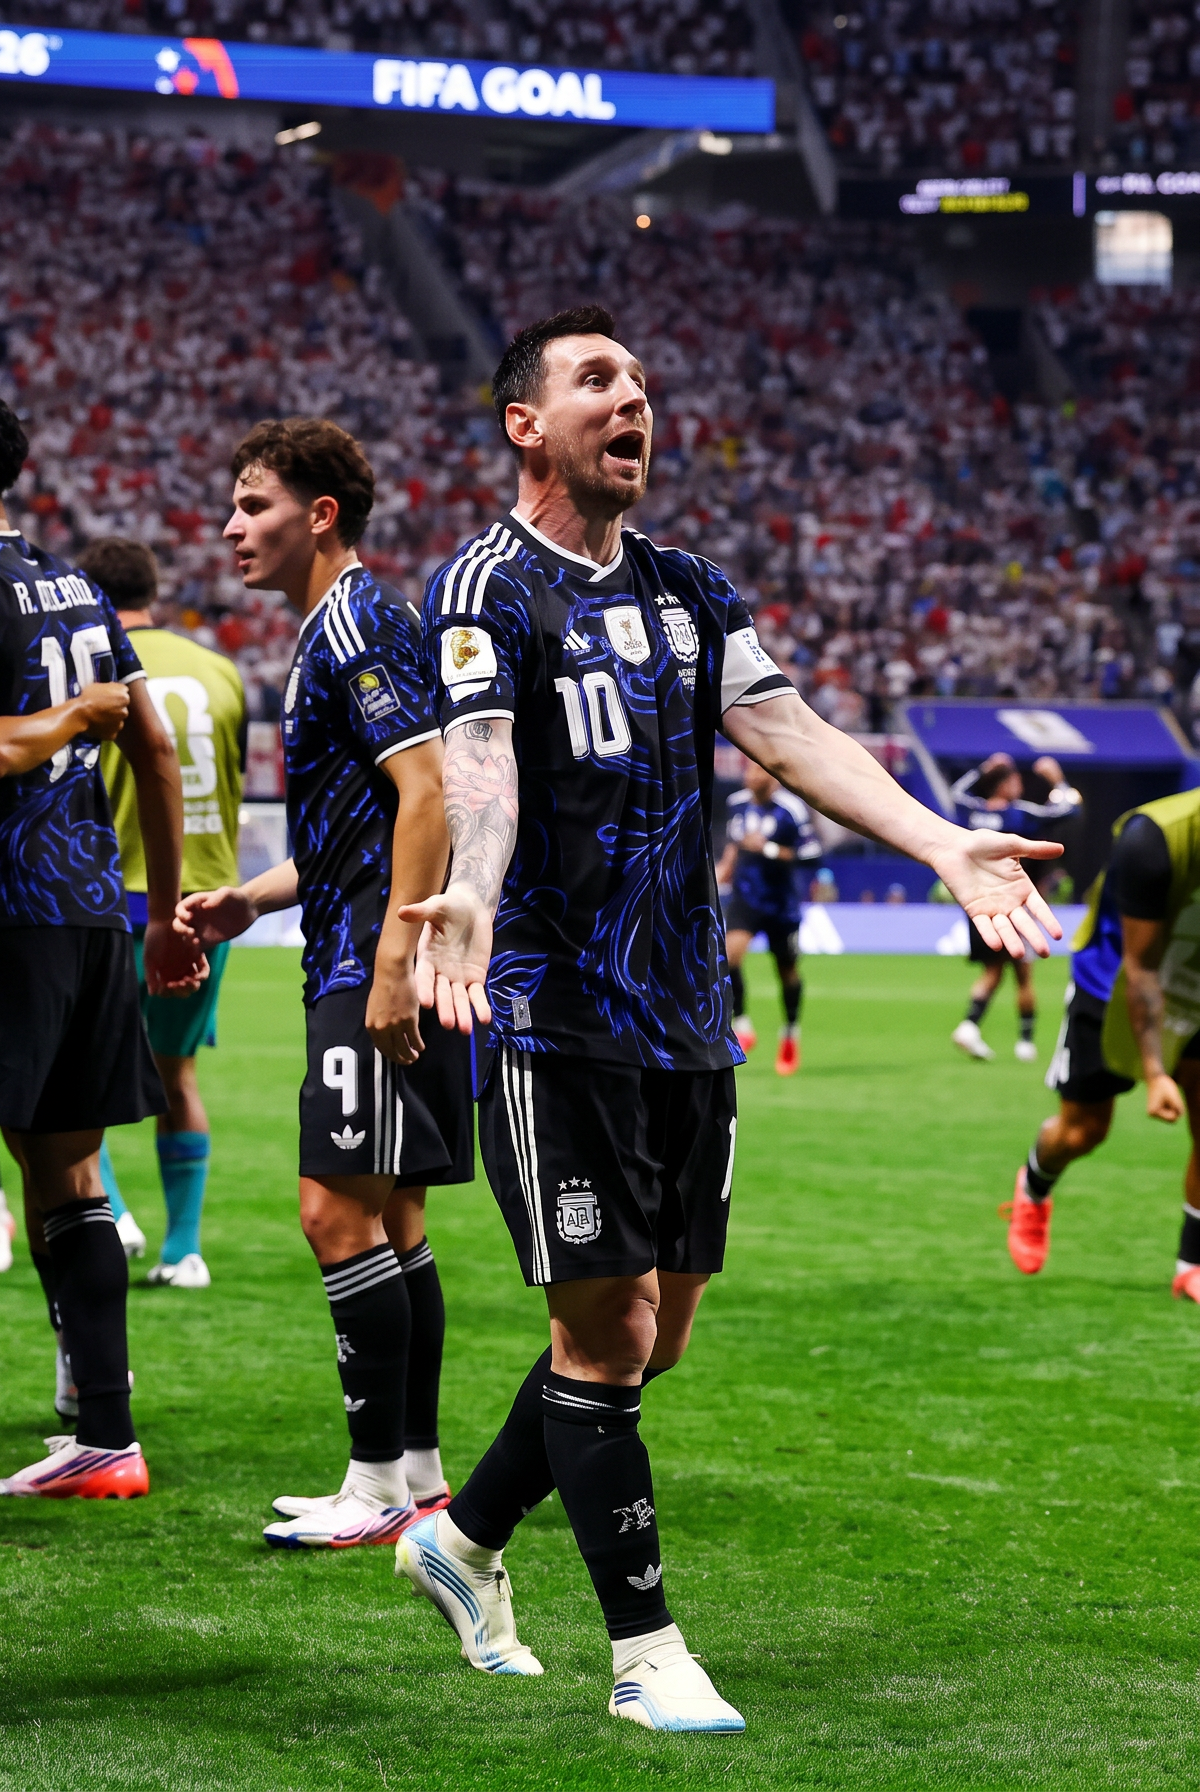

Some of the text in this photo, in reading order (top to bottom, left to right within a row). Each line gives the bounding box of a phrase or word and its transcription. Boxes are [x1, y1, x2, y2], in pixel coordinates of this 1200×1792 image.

[373, 58, 616, 120] FIFA GOAL
[554, 671, 632, 759] 10
[322, 1046, 359, 1117] 9
